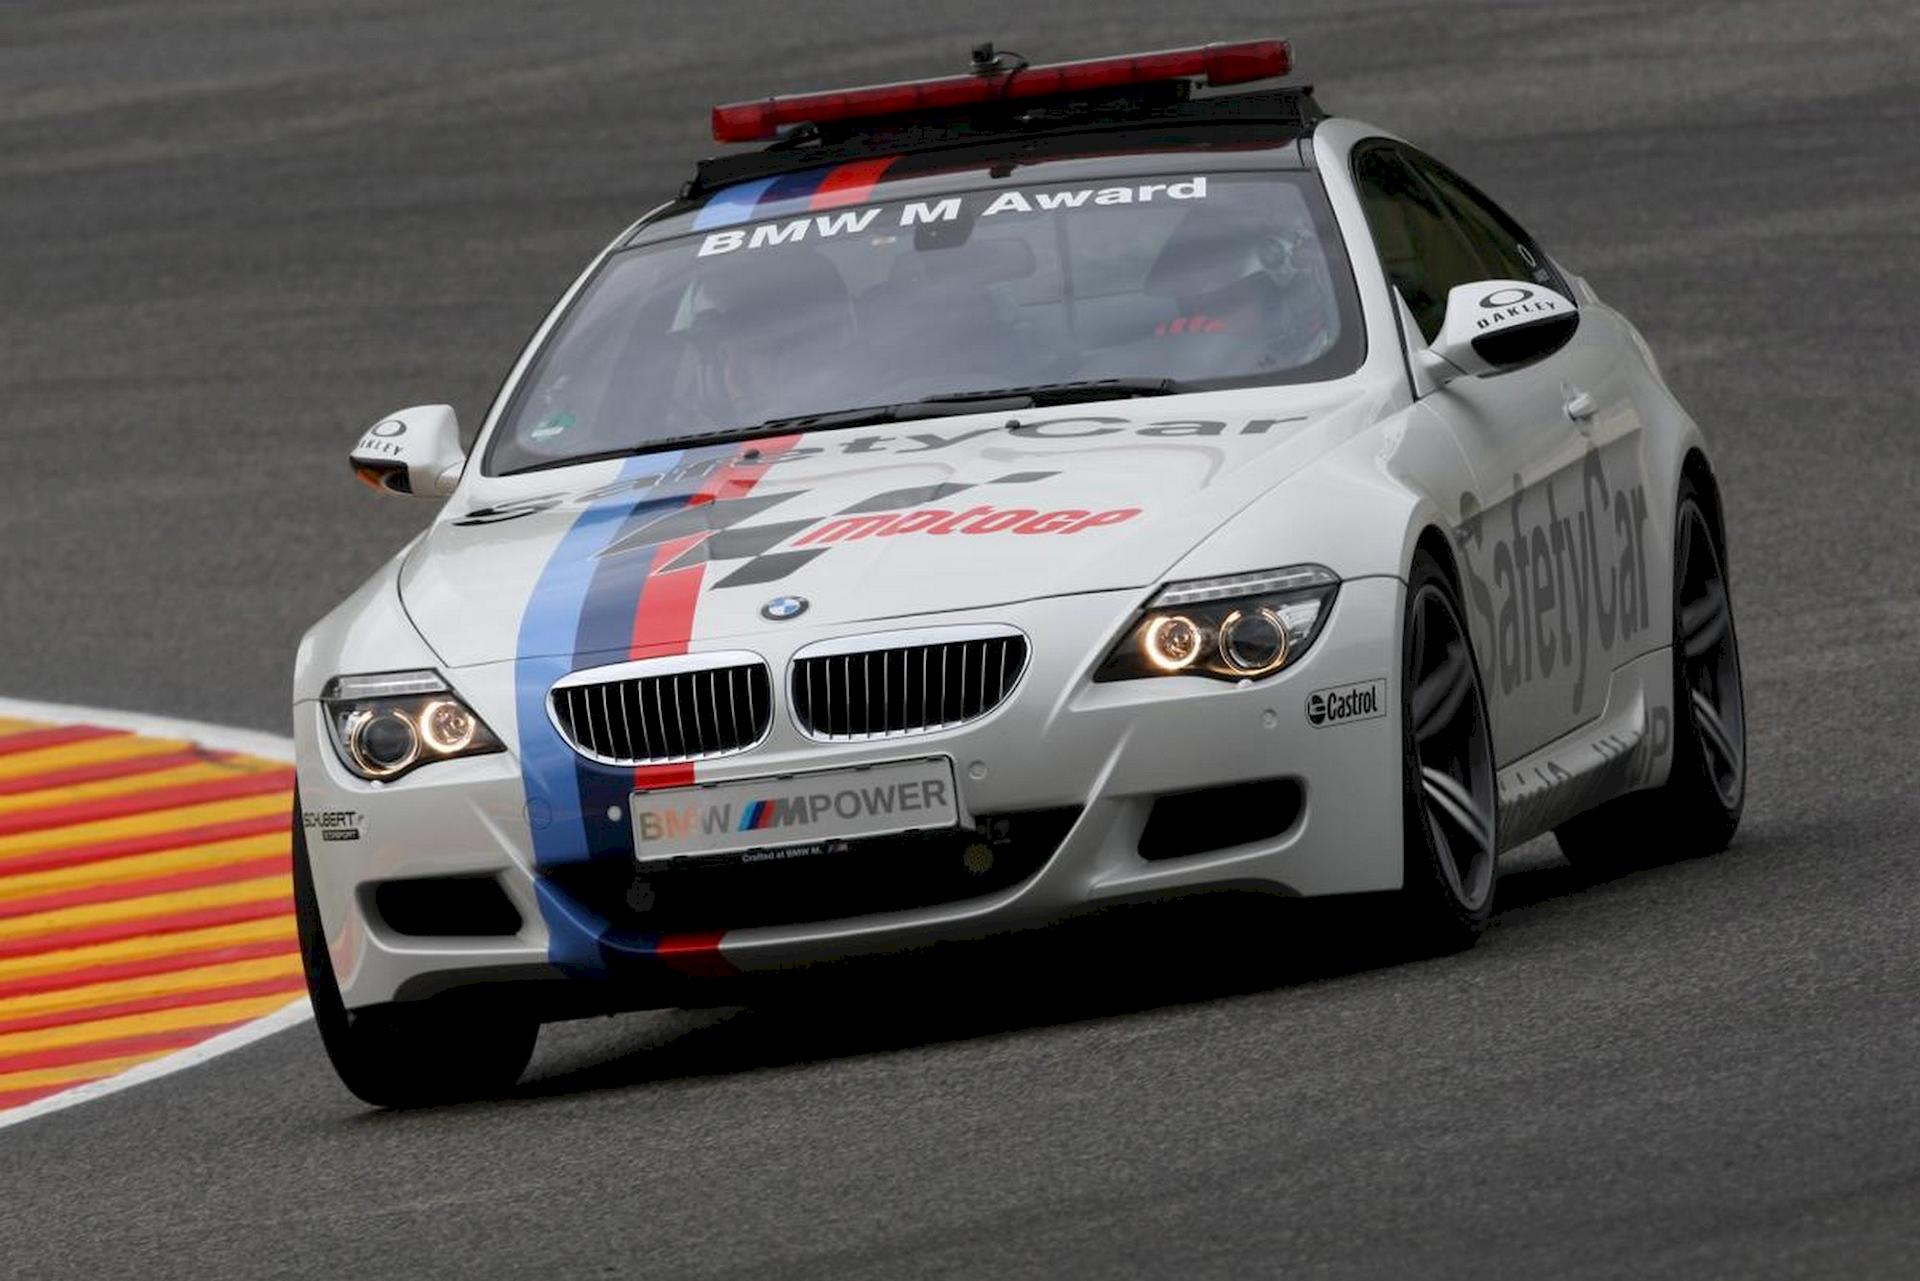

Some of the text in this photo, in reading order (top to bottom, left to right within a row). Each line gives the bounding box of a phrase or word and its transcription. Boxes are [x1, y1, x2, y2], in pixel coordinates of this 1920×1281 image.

[697, 177, 1207, 257] BMW M Award
[1476, 300, 1556, 329] OAKLEY
[1459, 446, 1650, 715] SafetyCar
[1327, 684, 1378, 721] Castrol
[639, 802, 732, 842] BMW
